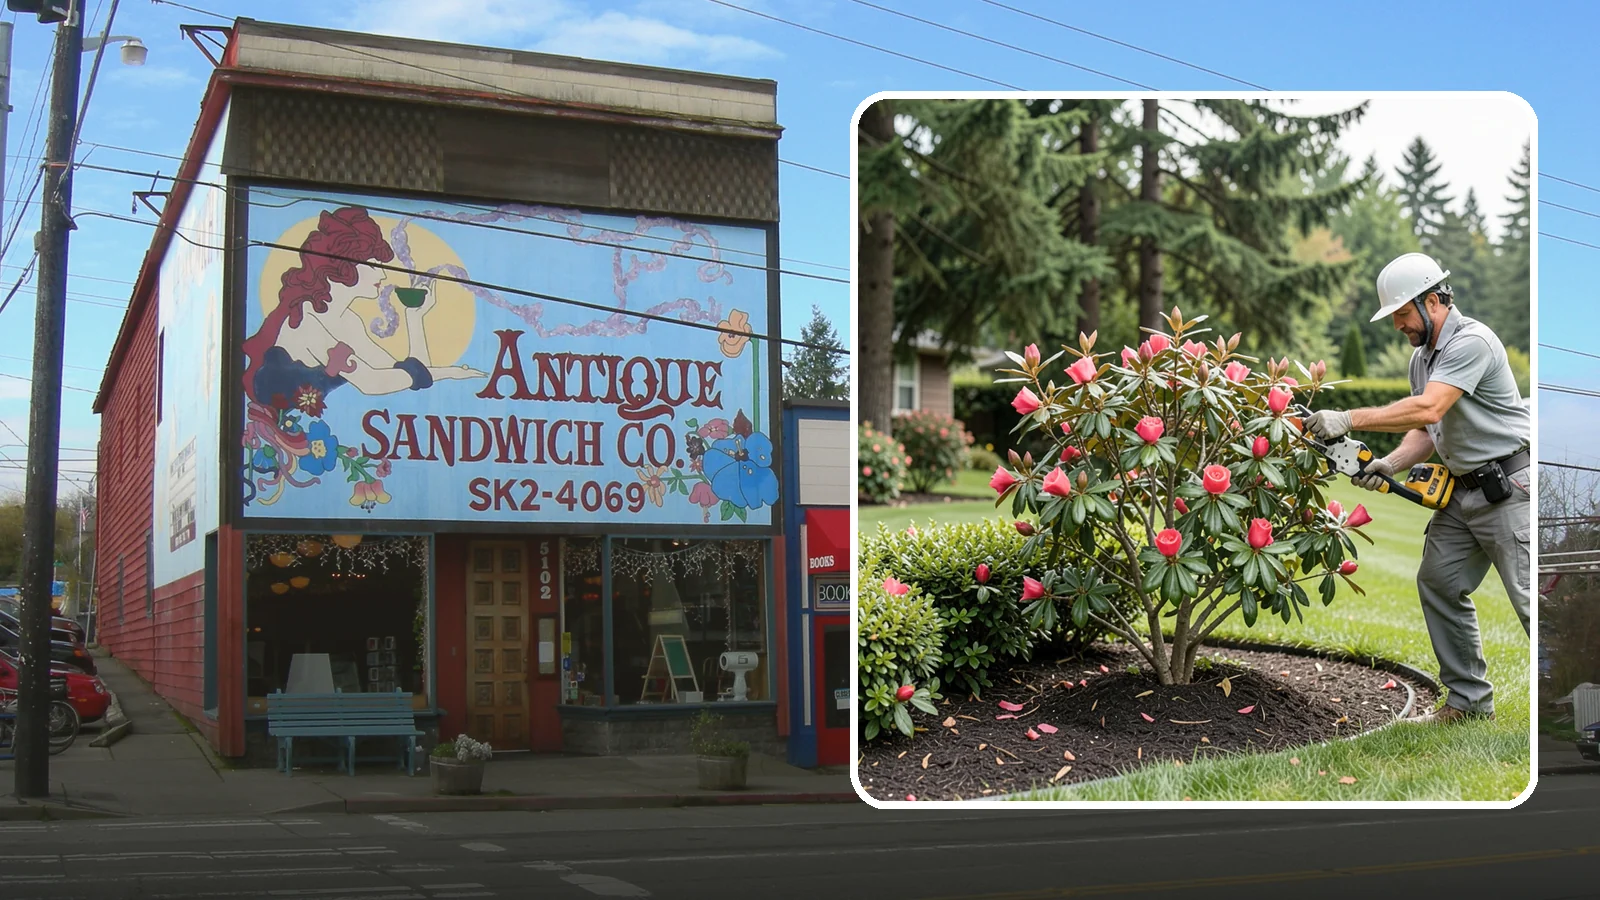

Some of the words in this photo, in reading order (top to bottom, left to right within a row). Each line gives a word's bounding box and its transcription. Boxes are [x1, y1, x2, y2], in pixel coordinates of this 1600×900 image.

[361, 408, 605, 468] SANDWICH
[616, 421, 685, 469] CO.
[468, 476, 646, 514] SK2-4069
[540, 541, 552, 600] 5102
[809, 555, 835, 569] BOOKS
